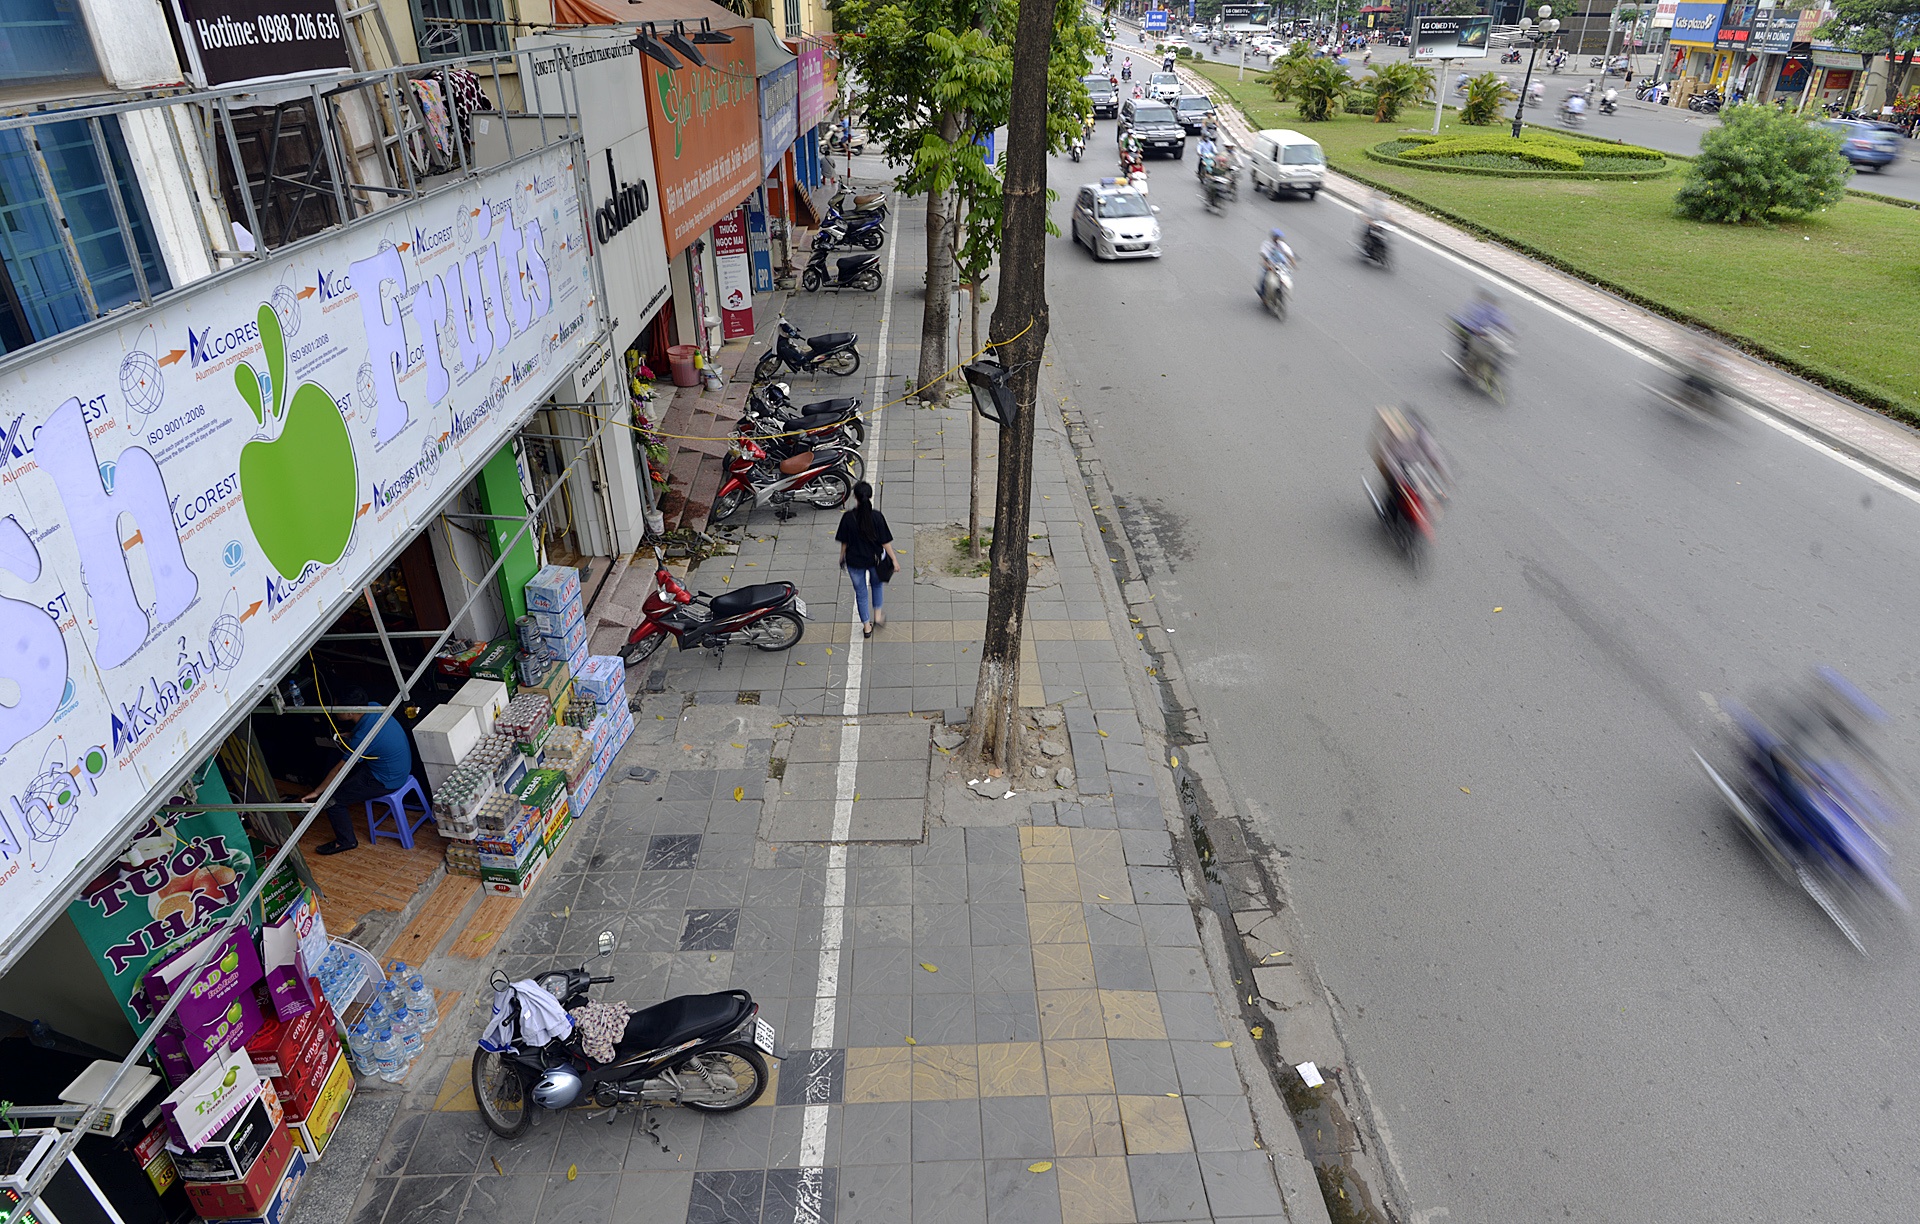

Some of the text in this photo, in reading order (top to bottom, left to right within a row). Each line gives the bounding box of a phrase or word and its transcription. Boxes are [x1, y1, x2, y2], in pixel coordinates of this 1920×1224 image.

[196, 13, 340, 50] Hotline: 0988 206 636
[1676, 17, 1705, 30] Kids plaza
[415, 225, 453, 256] ALCOREST
[349, 203, 551, 444] Fruits
[188, 320, 259, 369] ALCORES
[195, 346, 255, 382] Aluminum composite
[94, 417, 117, 438] panel
[147, 404, 206, 445] ISO 9001:2008
[200, 507, 227, 533] composite
[118, 680, 208, 770] Aluminum composite panel
[91, 836, 230, 917] TƯƠI
[263, 880, 295, 905] Heineken
[190, 969, 222, 999] T&D
[204, 1021, 229, 1052] T&D
[206, 1084, 238, 1115] Fresh Fruits
